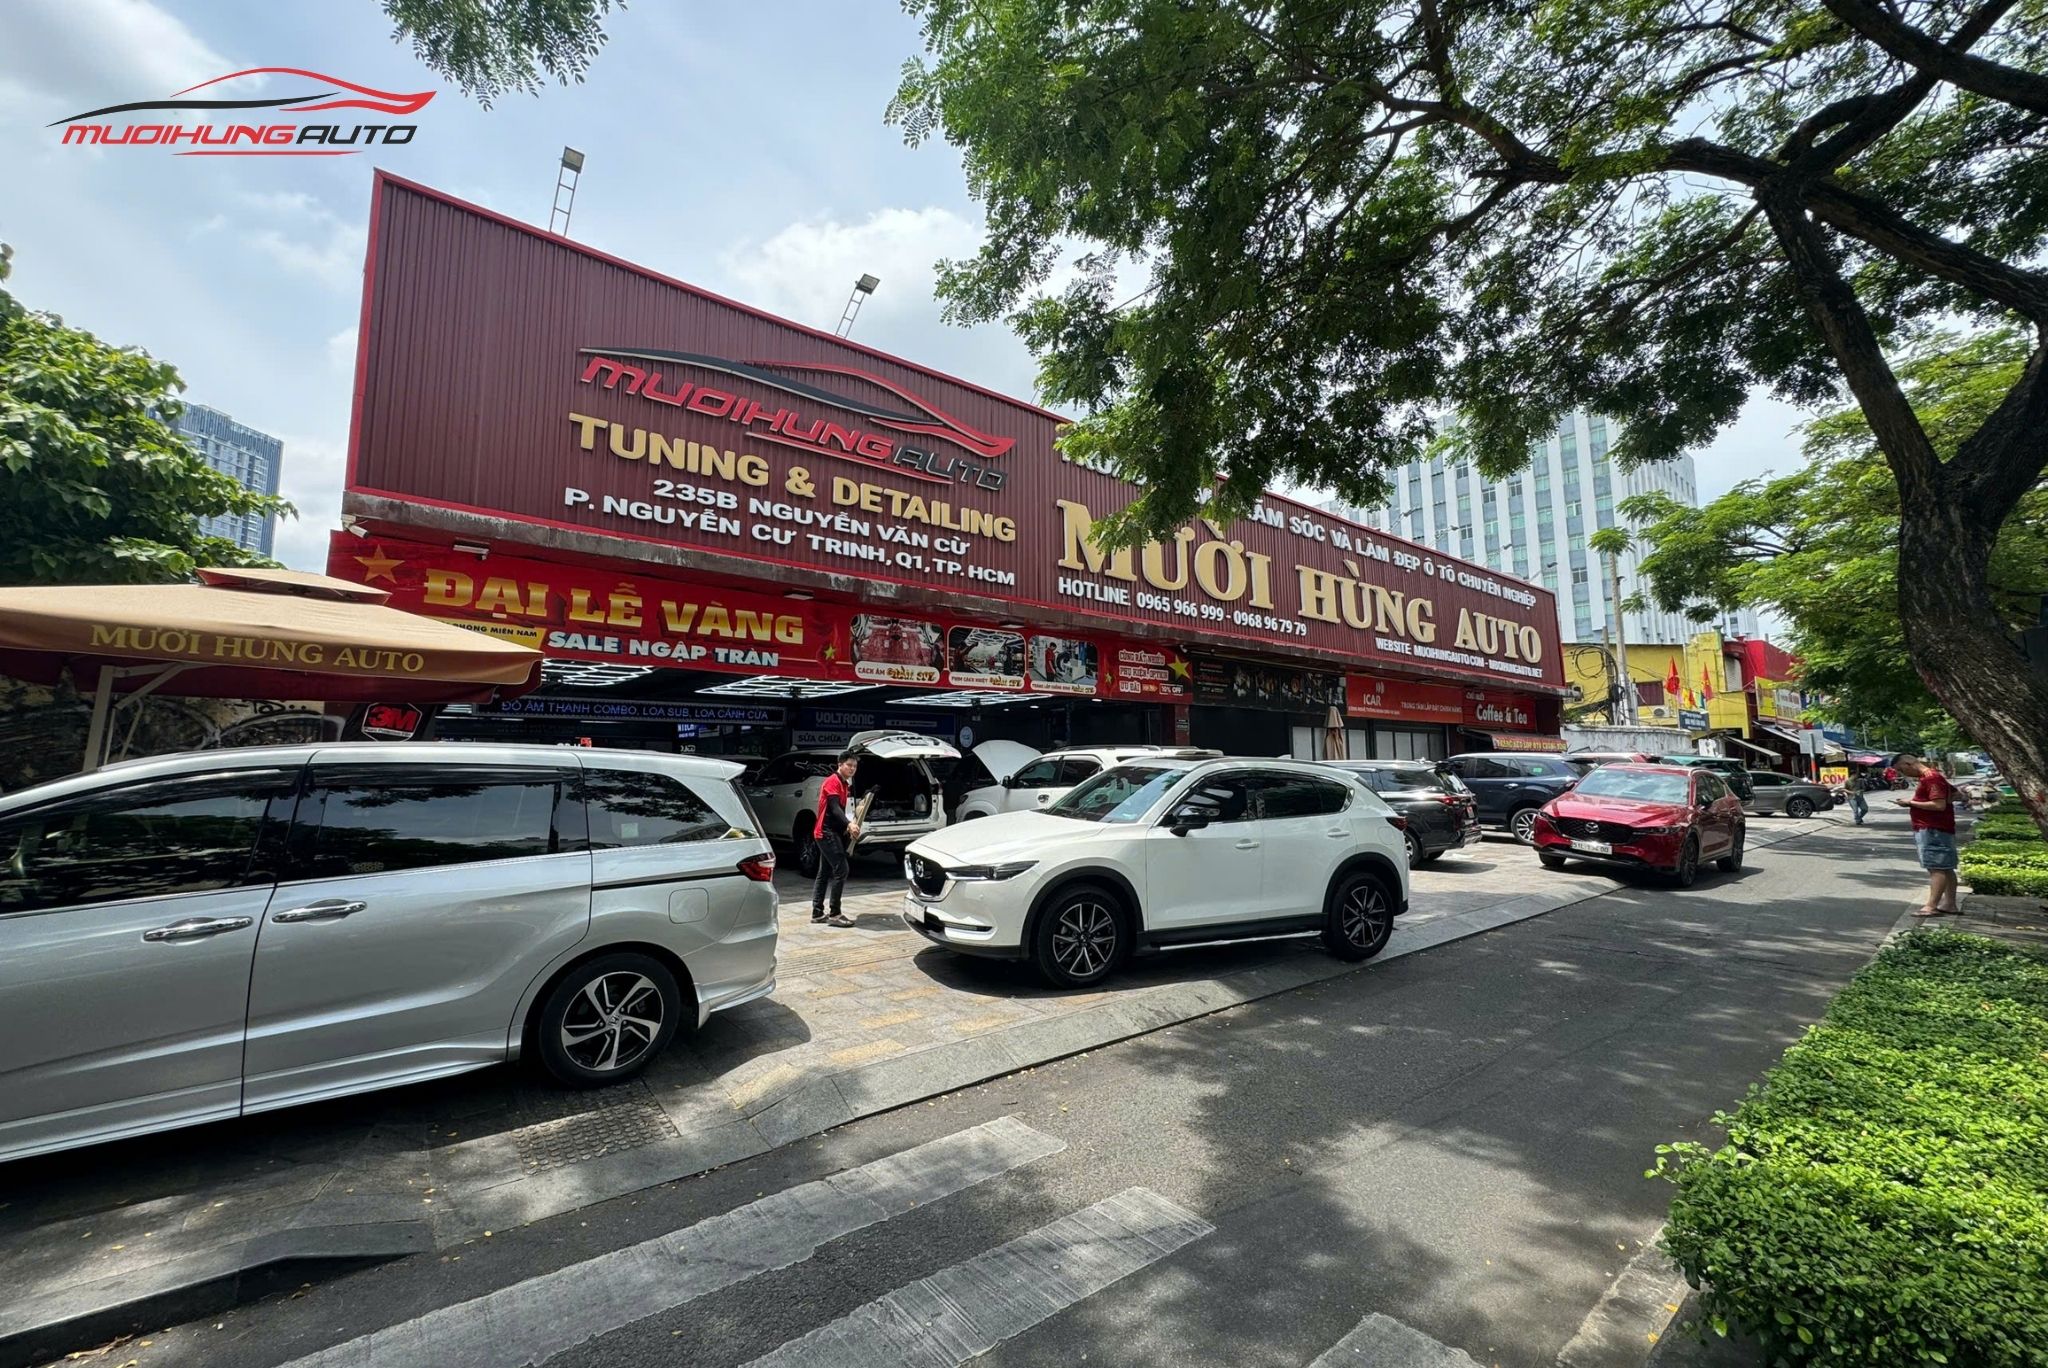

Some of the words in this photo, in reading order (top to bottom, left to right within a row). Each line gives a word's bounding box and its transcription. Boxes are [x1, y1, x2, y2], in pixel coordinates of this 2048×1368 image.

[568, 412, 769, 487] TUNING
[785, 466, 816, 498] &
[832, 476, 1016, 542] DETAILING
[564, 487, 595, 510] P.
[602, 495, 741, 537] NGUYỄN
[751, 524, 797, 545] CƯ
[653, 479, 738, 510] 235B
[749, 497, 870, 537] NGUYỄN
[876, 524, 929, 549] VĂN
[933, 535, 971, 556] CỪ
[1056, 499, 1275, 610] MƯỜI
[1295, 559, 1437, 643] HÙNG
[1454, 607, 1543, 664] AUTO
[1289, 514, 1326, 542] SÓC
[1329, 526, 1353, 551] VÀ
[1355, 537, 1390, 563] LÀM
[1392, 550, 1421, 573] ĐẸP
[1423, 557, 1435, 576] Ô
[1437, 564, 1456, 583] TÔ
[1458, 572, 1502, 597] CHUYÊN
[1503, 586, 1537, 610] NGHIỆP
[423, 568, 550, 619] ĐẠI
[568, 582, 644, 628] LỄ
[660, 600, 805, 645] VÀNG
[1136, 591, 1171, 613] 0965
[1173, 599, 1198, 618] 966
[1200, 604, 1224, 622] 999
[1233, 610, 1262, 629] 0968
[516, 630, 537, 638] NAM
[548, 630, 620, 653] SALE
[628, 639, 707, 664] NGẬP
[713, 646, 779, 667] TRÀN
[333, 648, 425, 672] AUTO
[367, 705, 418, 732] 3M
[1476, 703, 1504, 722] Coffee
